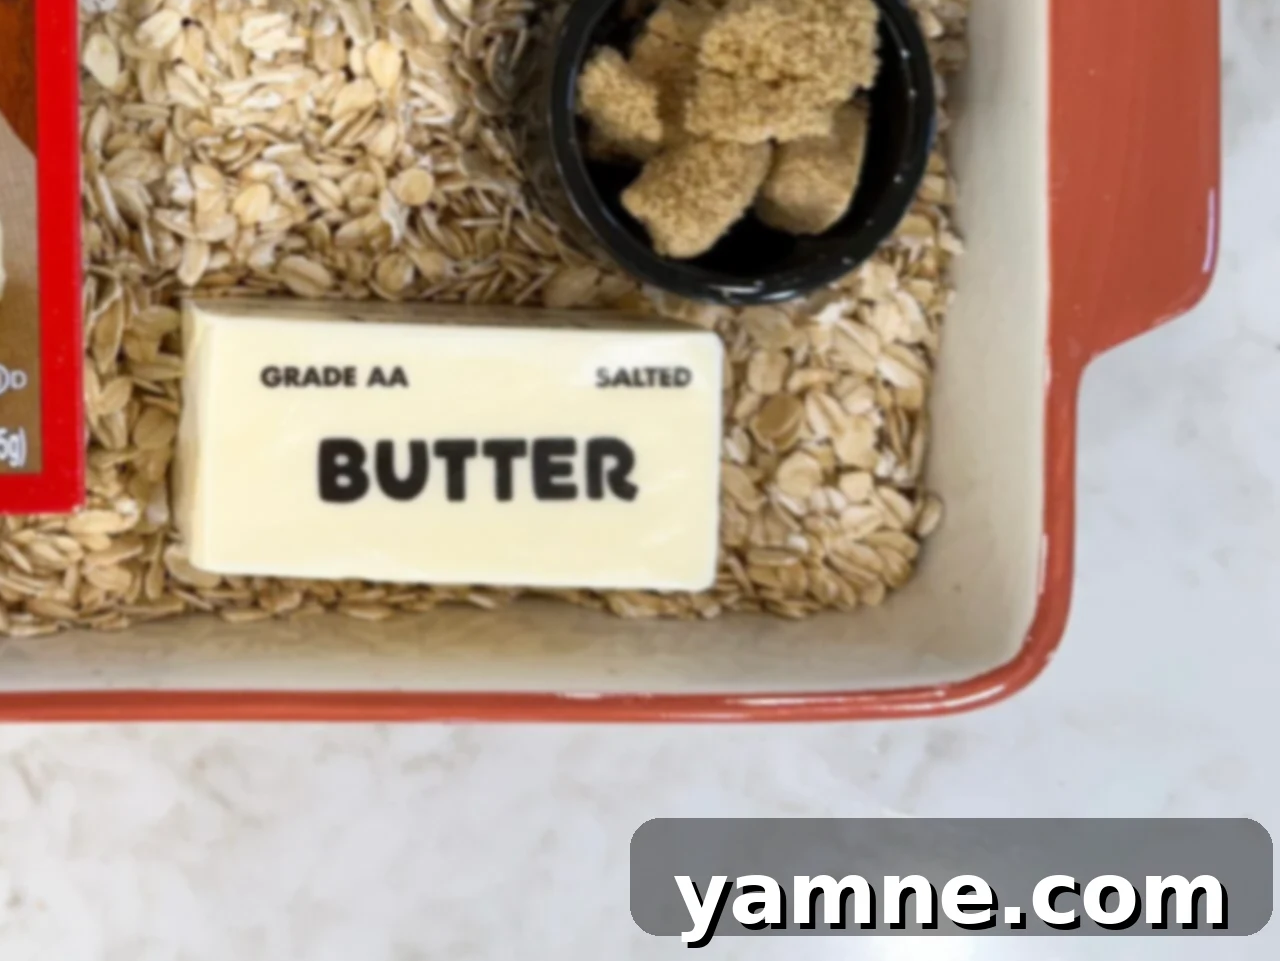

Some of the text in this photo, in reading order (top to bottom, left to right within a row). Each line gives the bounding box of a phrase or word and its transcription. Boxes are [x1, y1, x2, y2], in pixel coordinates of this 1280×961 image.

[260, 365, 410, 389] GRADE AA
[595, 366, 694, 389] SALTED
[318, 436, 640, 504] BUTTER
